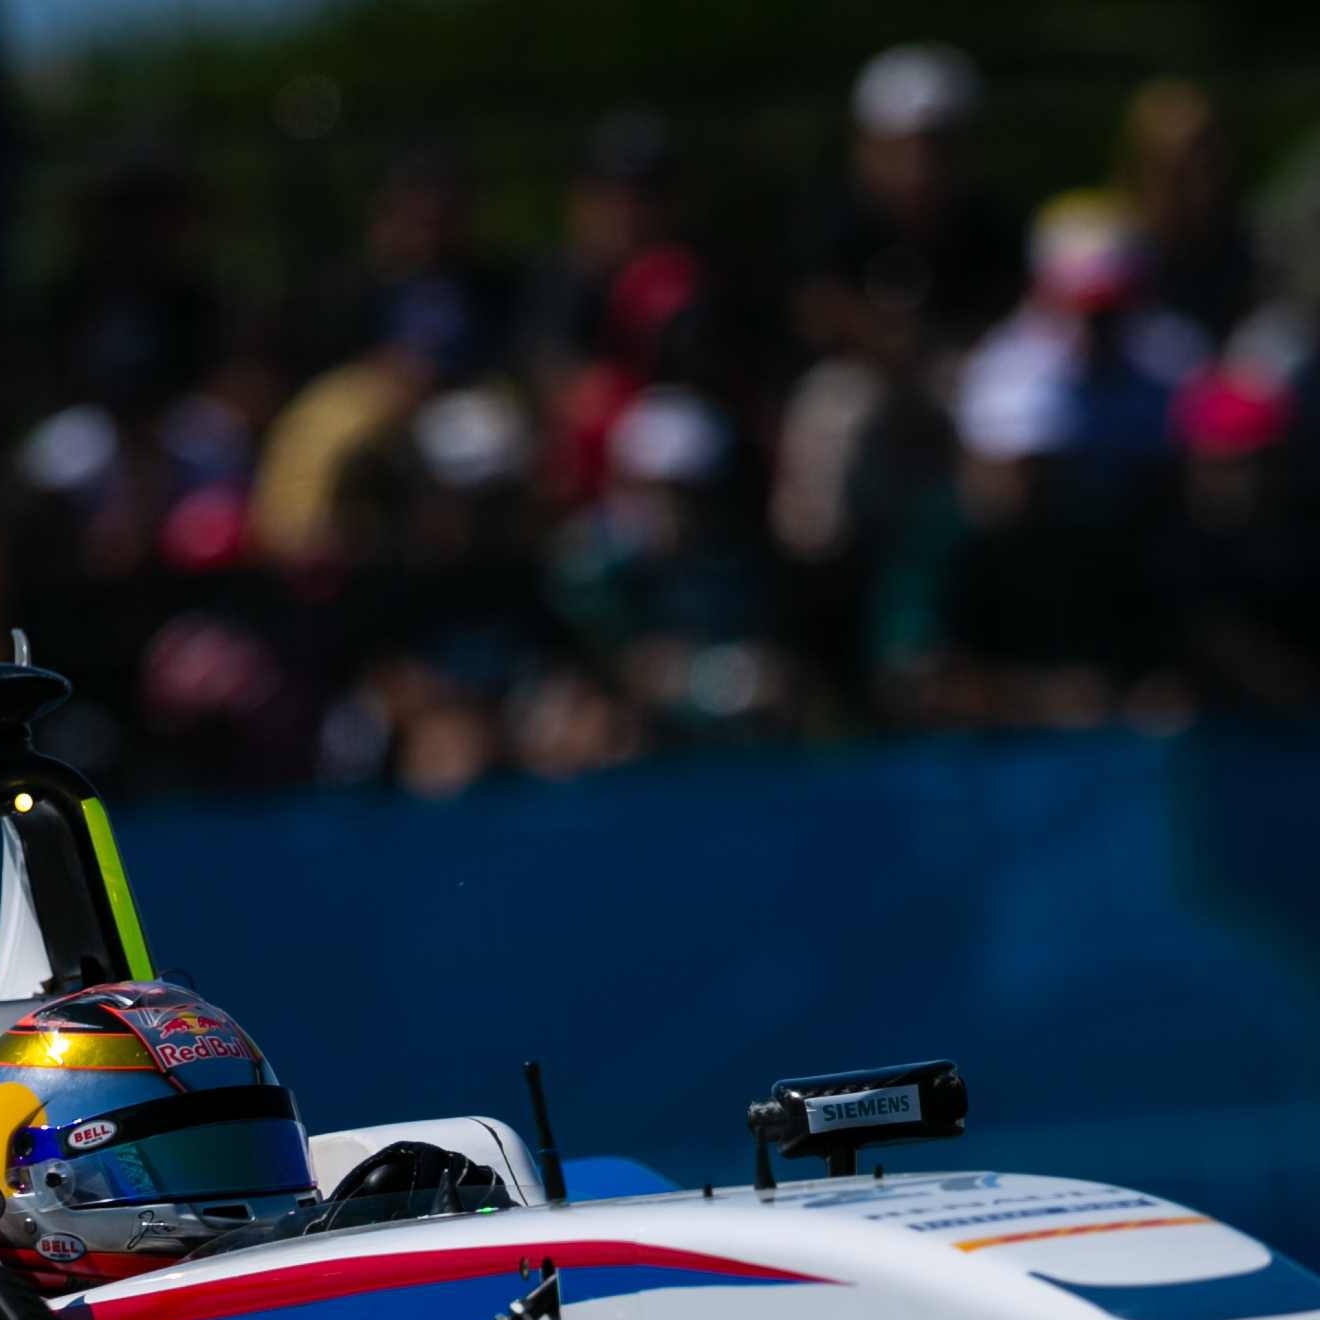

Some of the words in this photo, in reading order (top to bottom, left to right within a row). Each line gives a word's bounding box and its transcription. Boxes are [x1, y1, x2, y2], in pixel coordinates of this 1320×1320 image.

[822, 1094, 911, 1122] SIEMENS
[73, 1124, 111, 1144] BELL
[41, 1239, 80, 1254] BELL
